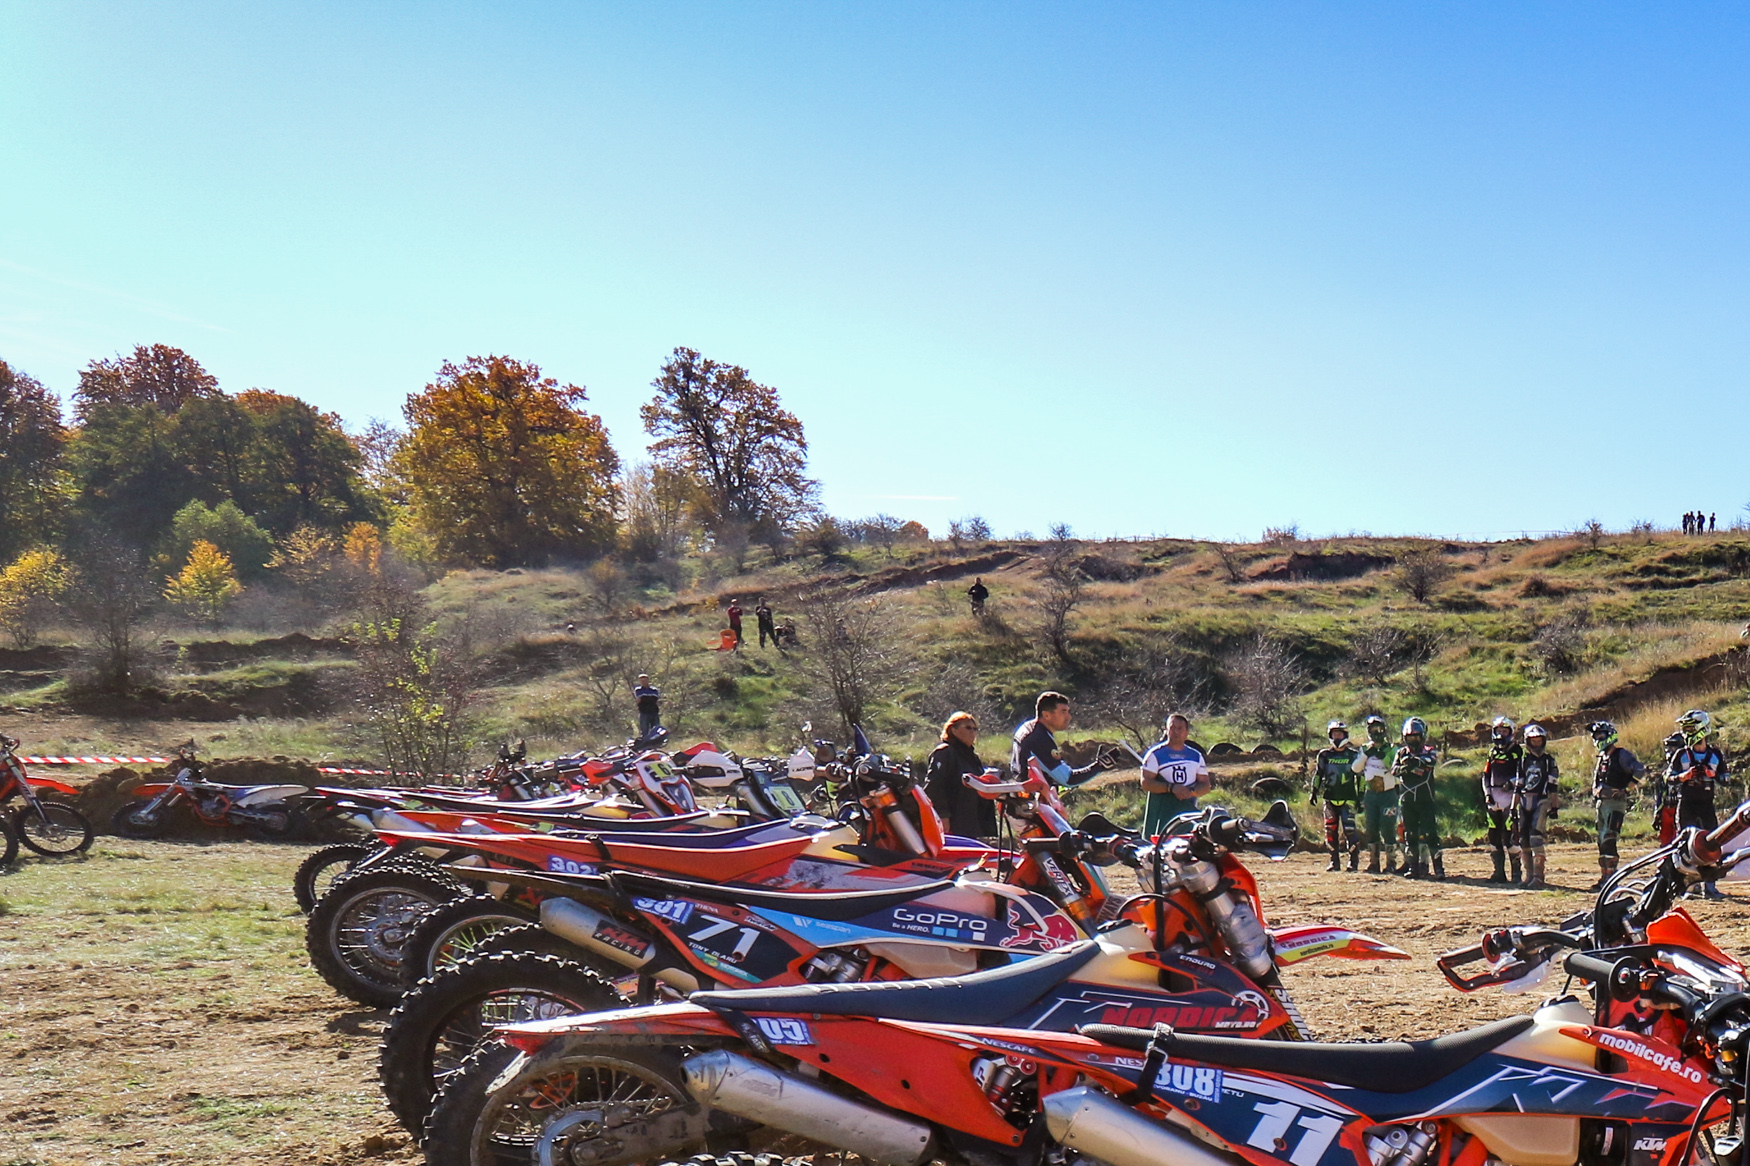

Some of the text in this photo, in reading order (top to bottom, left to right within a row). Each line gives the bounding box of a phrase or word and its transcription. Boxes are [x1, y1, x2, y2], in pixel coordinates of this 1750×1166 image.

[893, 908, 987, 931] GoPro
[594, 932, 640, 956] RACING
[688, 914, 760, 958] 71
[1179, 955, 1216, 970] ENDURO
[757, 1017, 806, 1042] 05
[1599, 1032, 1702, 1084] mobilcafe.ro
